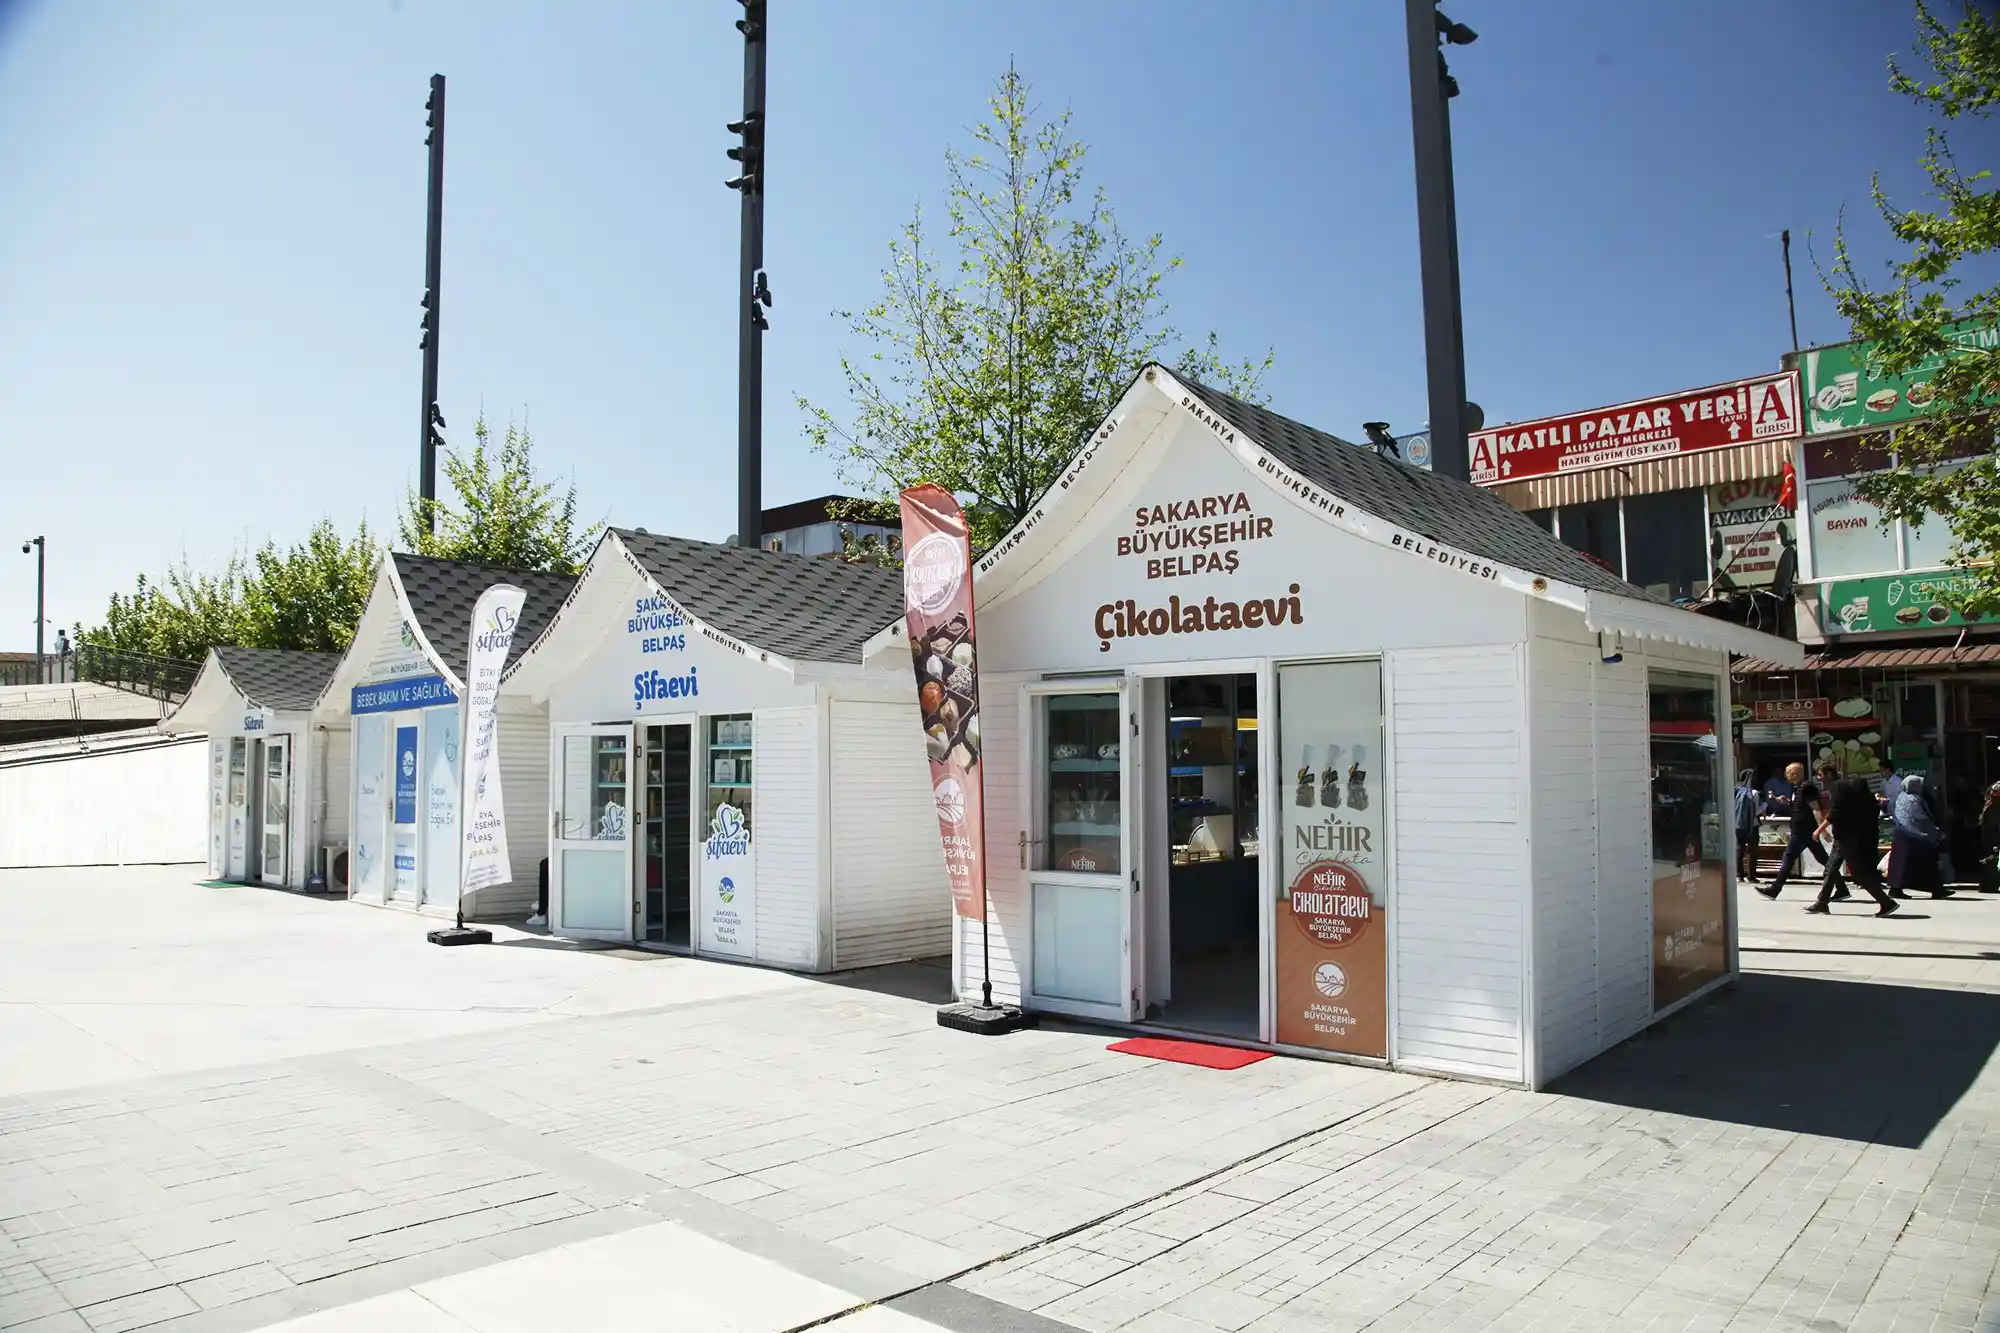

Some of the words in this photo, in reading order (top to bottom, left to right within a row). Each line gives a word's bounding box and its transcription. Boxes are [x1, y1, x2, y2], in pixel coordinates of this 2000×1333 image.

[1755, 384, 1790, 425] A
[1498, 424, 1571, 455] KATLI
[1579, 406, 1672, 441] PAZAR
[1679, 387, 1748, 423] YERİ
[1755, 421, 1791, 436] GİRİŞİ
[1565, 436, 1620, 454] ALIŞVERİŞ
[1622, 426, 1672, 445] MERKEZİ
[1470, 437, 1496, 472] A
[1561, 454, 1590, 468] HAZIR
[1593, 450, 1623, 463] GİYİM
[1626, 445, 1649, 457] (ÜST
[1652, 440, 1677, 453] KAT)
[1181, 396, 1235, 444] SAKARYA
[1391, 533, 1498, 581] BELEDIYESI
[1135, 491, 1252, 527] SAKARYA
[1117, 513, 1274, 557] BÜYÜKŞEHİR
[1827, 516, 1868, 531] BAYAN
[1147, 549, 1240, 580] BELPAŞ
[1094, 582, 1304, 653] Çikolataevi
[642, 633, 686, 654] BELPAŞ
[355, 690, 378, 708] BEBEK
[378, 688, 399, 705] BAKIM
[400, 687, 411, 702] VE
[411, 681, 441, 701] SAĞLIK
[633, 665, 699, 711] Şifaevi
[243, 714, 265, 731] Sütevi
[706, 833, 748, 860] şifaevi
[1295, 820, 1373, 853] NEHİR
[1313, 871, 1347, 887] NEHİR
[1308, 923, 1352, 934] BÜYÜKŞEHİR
[1314, 917, 1346, 926] SAKARYA
[1318, 931, 1342, 942] BELPAŞ
[1303, 1010, 1357, 1025] BÜYÜKŞEHİR
[1310, 1003, 1349, 1015] SAKARYA
[1314, 1023, 1346, 1036] BELPAŞ
